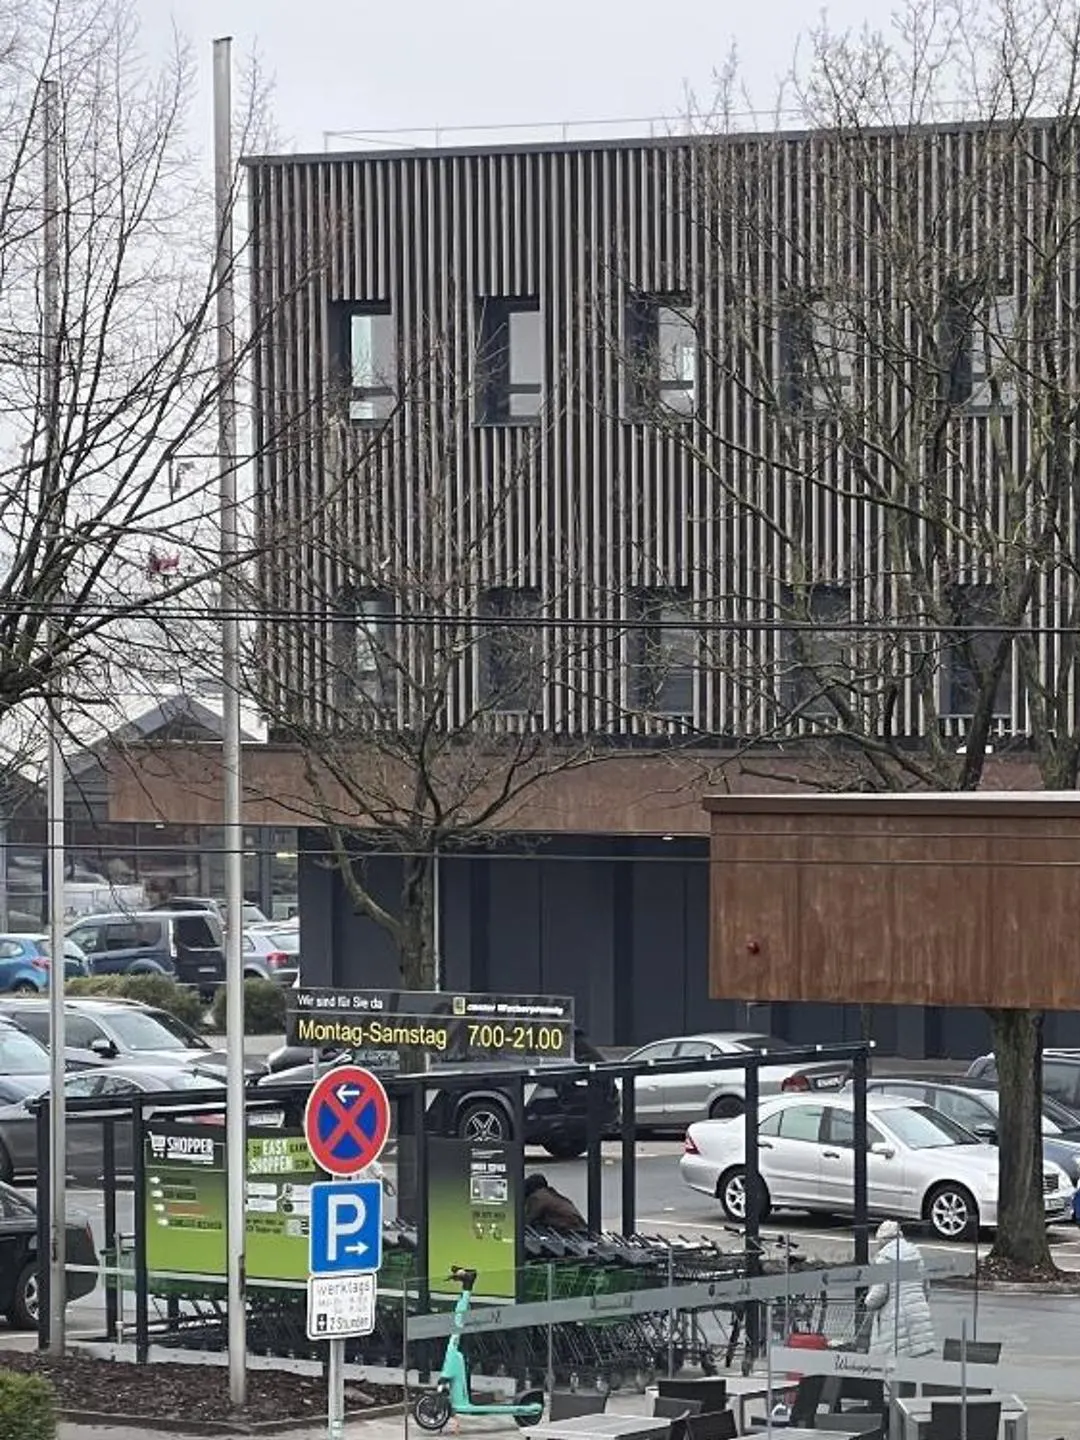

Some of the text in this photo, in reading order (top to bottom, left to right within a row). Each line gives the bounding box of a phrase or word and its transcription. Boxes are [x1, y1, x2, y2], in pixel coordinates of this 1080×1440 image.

[297, 994, 314, 1006] Wir
[316, 996, 336, 1008] sind
[353, 996, 369, 1009] Sie
[370, 995, 383, 1010] da
[299, 1020, 562, 1050] Montag-Samstag 7.00-21.00
[166, 1136, 214, 1154] SHOPPER
[326, 1194, 366, 1261] P
